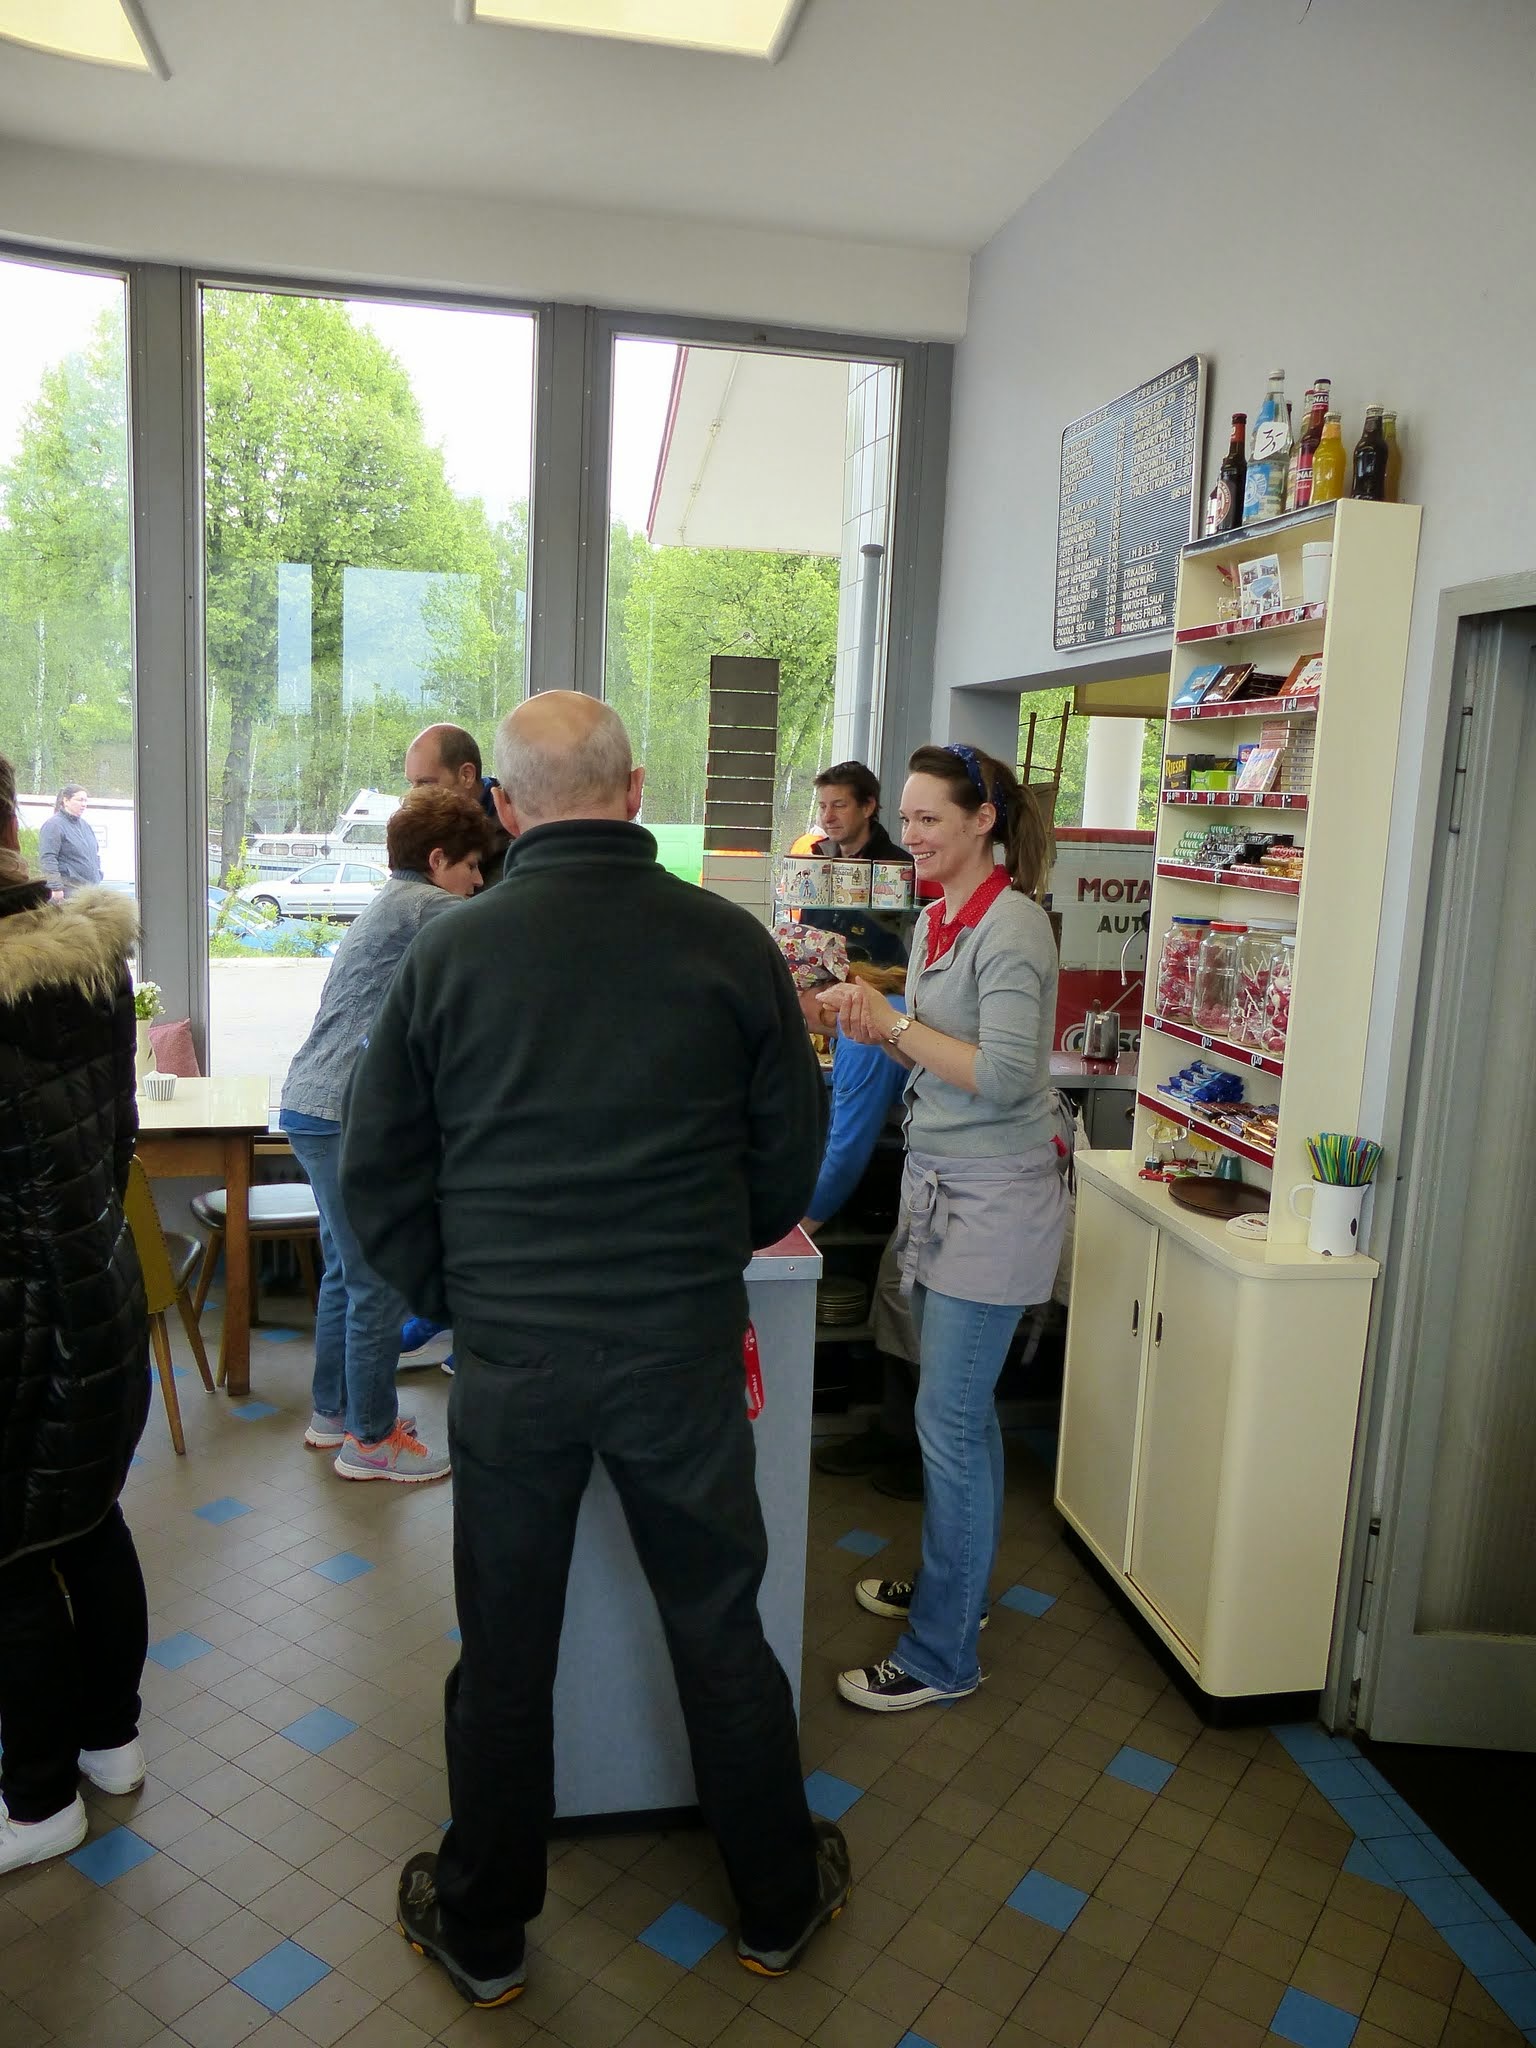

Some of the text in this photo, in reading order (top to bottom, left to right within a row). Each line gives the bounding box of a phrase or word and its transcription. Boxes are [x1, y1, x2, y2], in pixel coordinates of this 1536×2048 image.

[1123, 562, 1154, 579] FRIKADELLE
[1122, 572, 1157, 590] CURRYWURST
[1122, 592, 1164, 611] KARTOFFELSALAT
[1121, 604, 1162, 622] POMMES FRITES
[1075, 622, 1087, 632] SEKT
[1165, 759, 1188, 776] RIESEN
